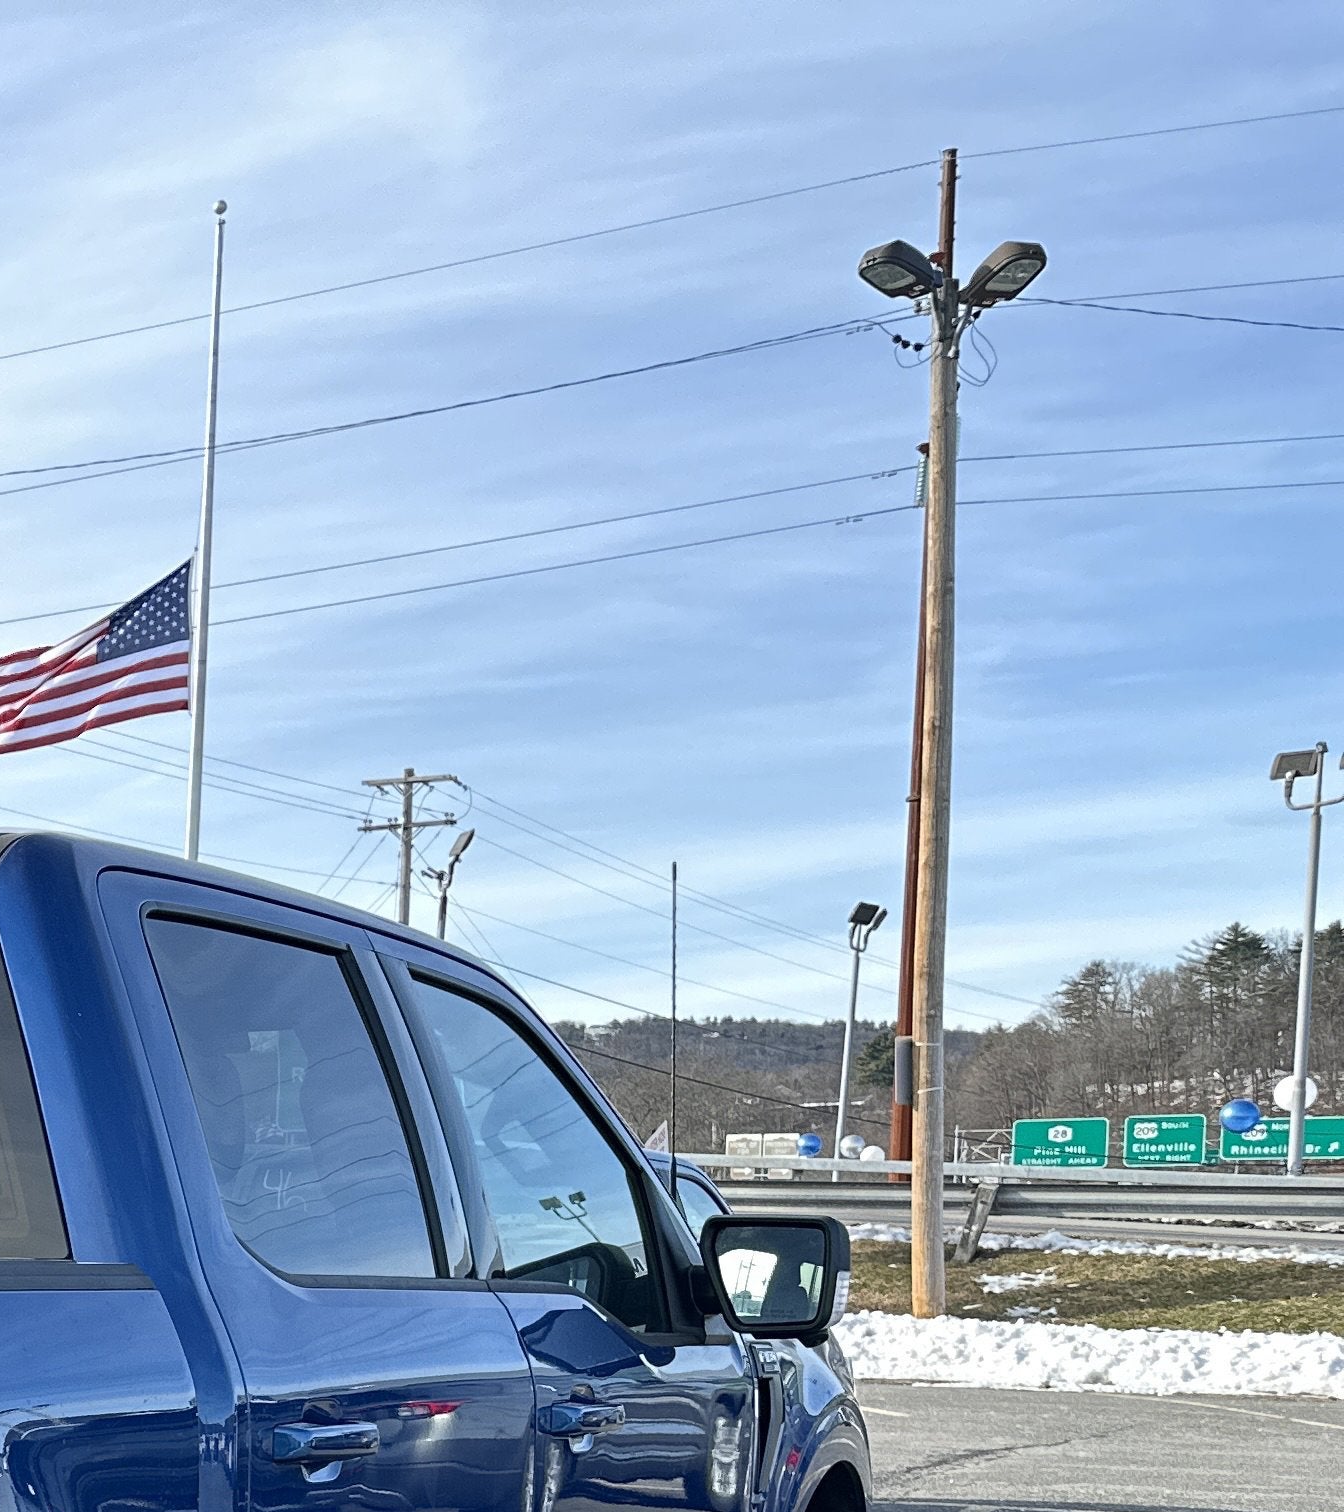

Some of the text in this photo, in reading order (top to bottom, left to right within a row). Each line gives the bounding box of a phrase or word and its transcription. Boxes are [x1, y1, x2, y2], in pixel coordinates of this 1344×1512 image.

[1052, 1129, 1068, 1139] 28
[1135, 1126, 1156, 1136] 209
[1132, 1142, 1197, 1153] Ellenville
